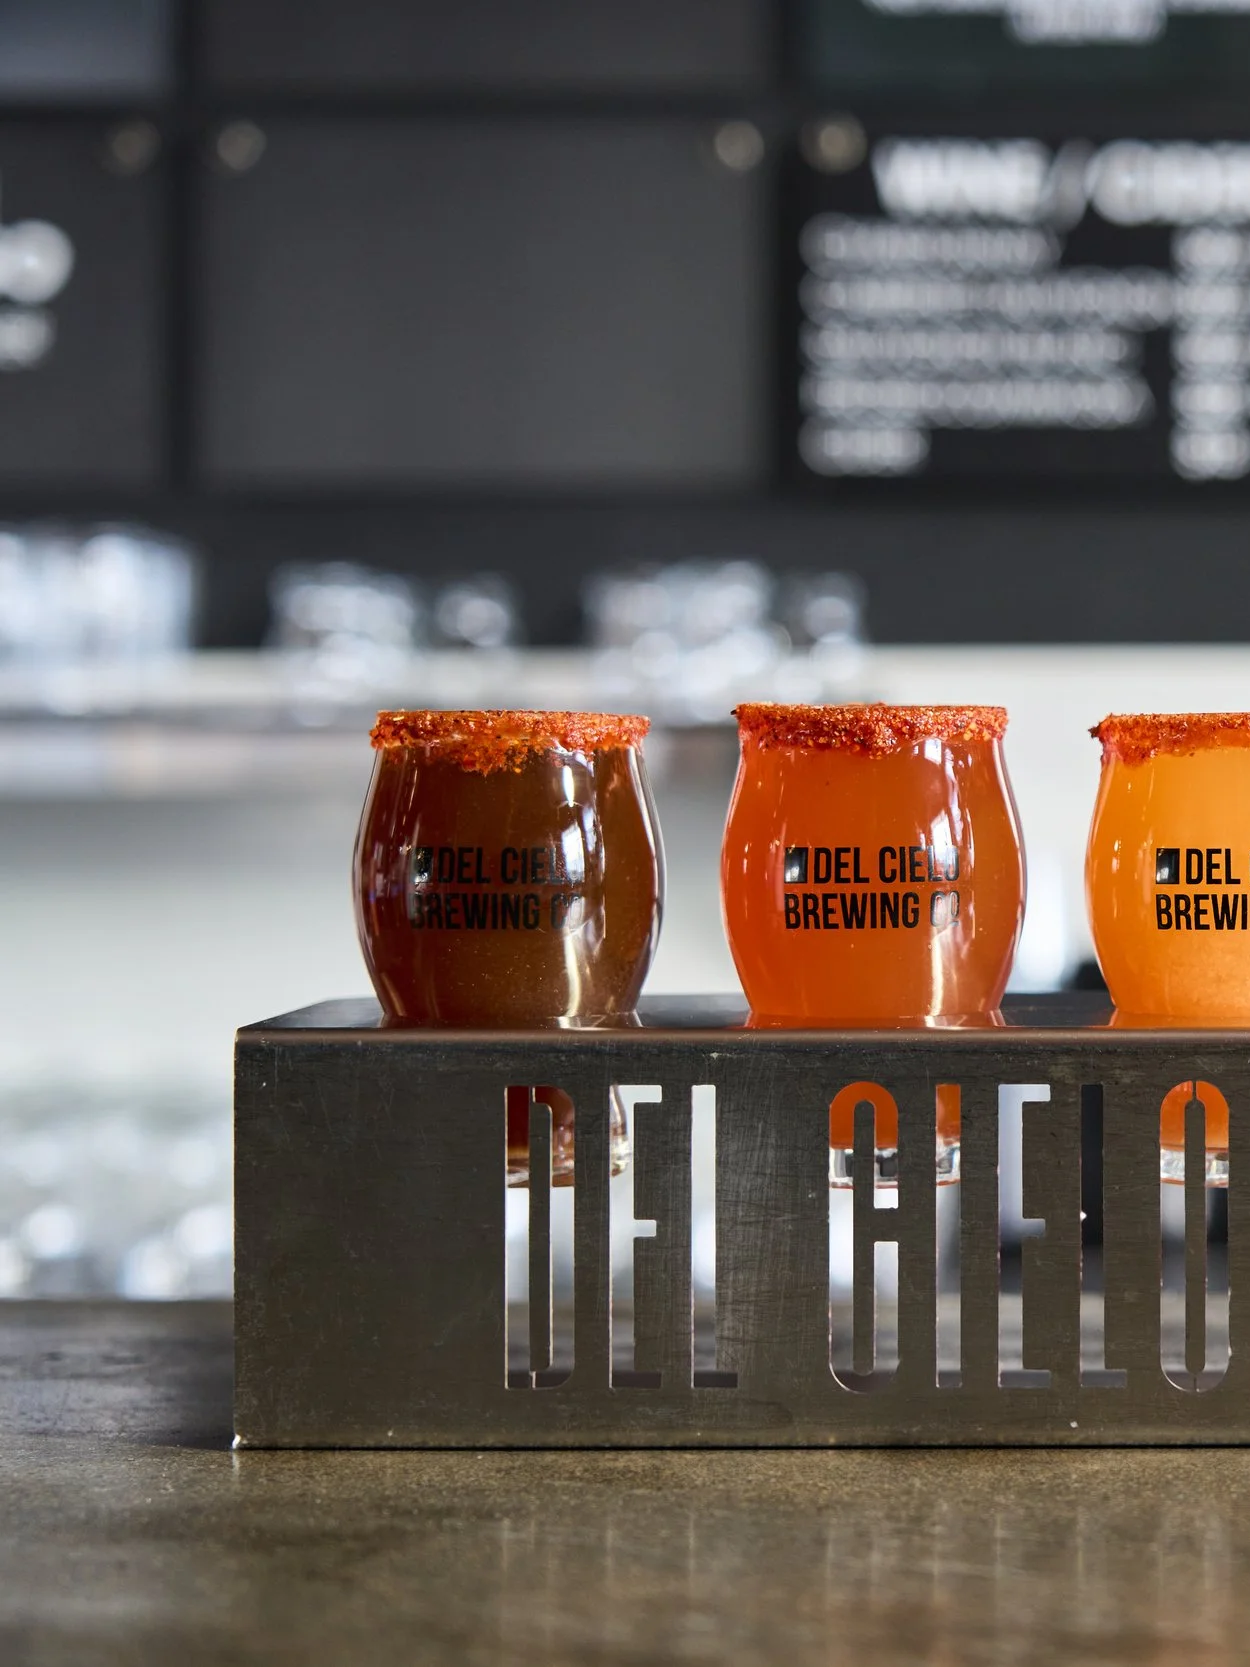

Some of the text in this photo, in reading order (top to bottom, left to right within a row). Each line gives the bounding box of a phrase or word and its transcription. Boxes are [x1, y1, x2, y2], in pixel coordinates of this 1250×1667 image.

[438, 847, 491, 883] DEL
[814, 847, 869, 883] DEL
[1185, 848, 1240, 884] DEL
[784, 892, 920, 929] BREWING
[504, 1085, 738, 1388] DEL
[828, 1081, 1229, 1392] CIELO
